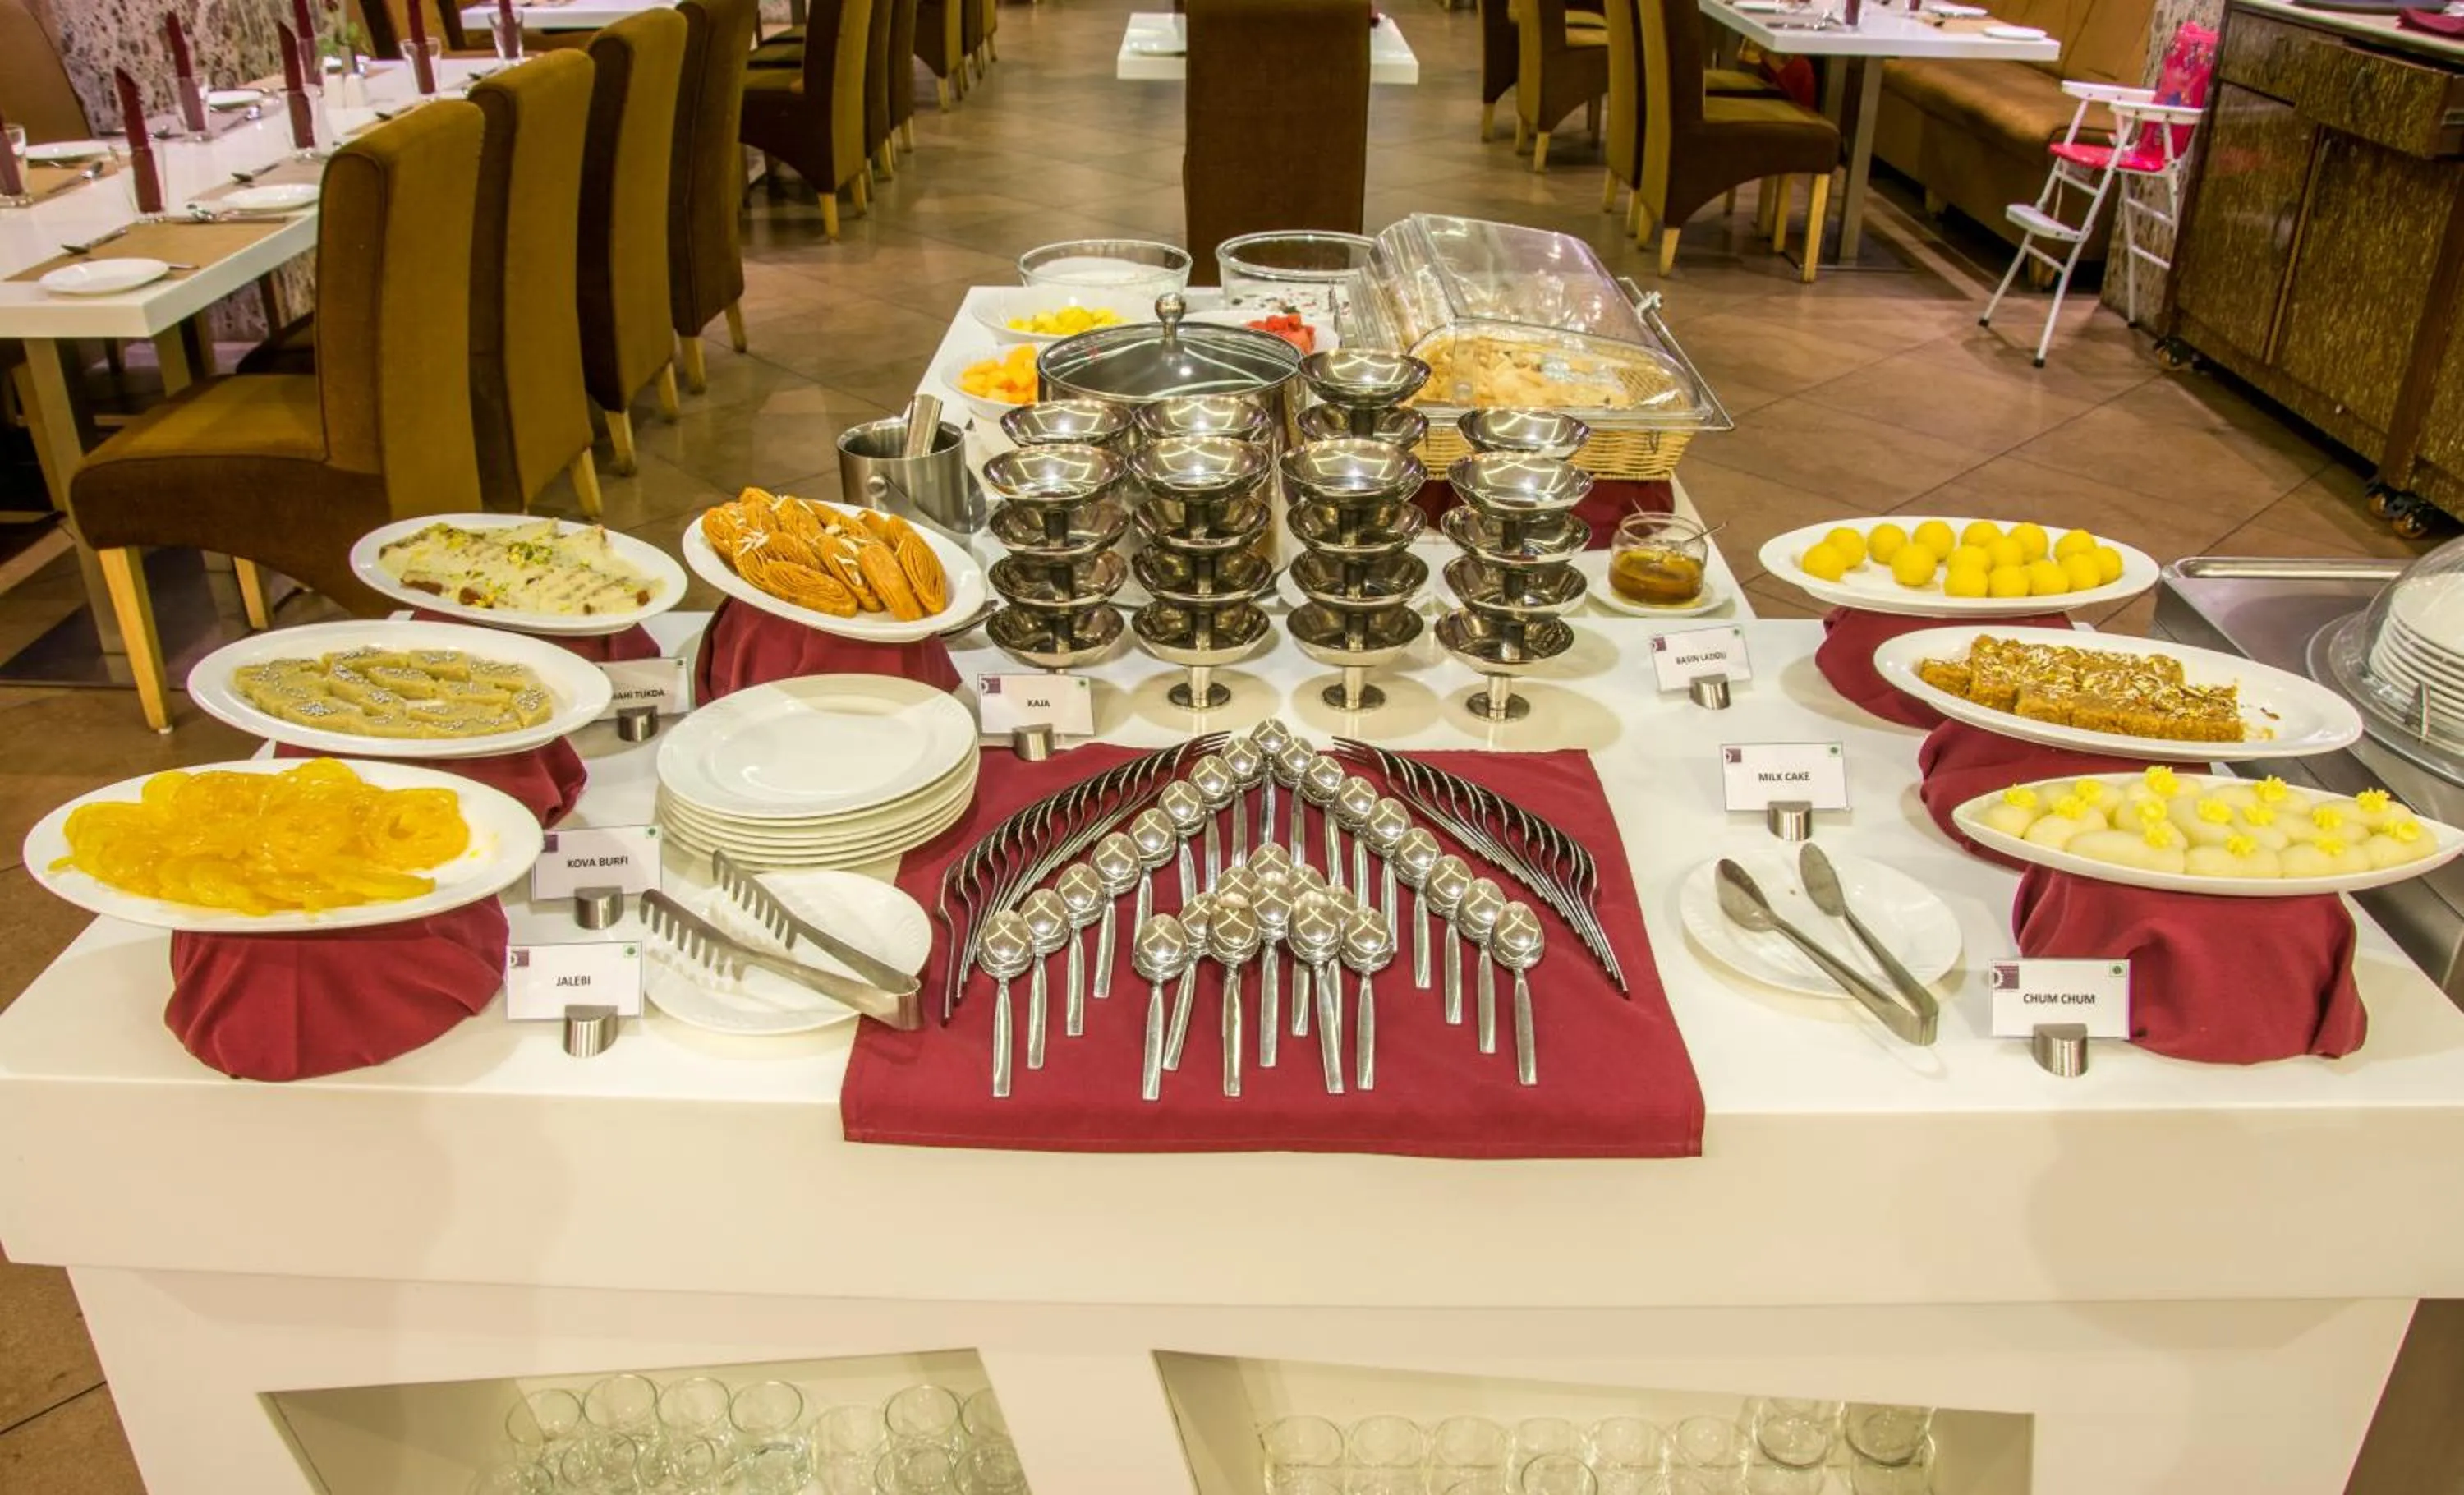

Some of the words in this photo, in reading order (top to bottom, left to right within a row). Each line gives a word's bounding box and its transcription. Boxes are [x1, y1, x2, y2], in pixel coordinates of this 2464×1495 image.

[634, 689, 664, 698] TUKDA
[1027, 699, 1050, 707] KAJA
[1758, 772, 1782, 781] MILK
[1785, 771, 1811, 781] CAKE
[567, 858, 595, 868] KOVA
[599, 856, 628, 867] BURFI
[556, 975, 591, 986] JALEBI
[2023, 993, 2057, 1004] CHUM
[2060, 993, 2095, 1004] CHUM
